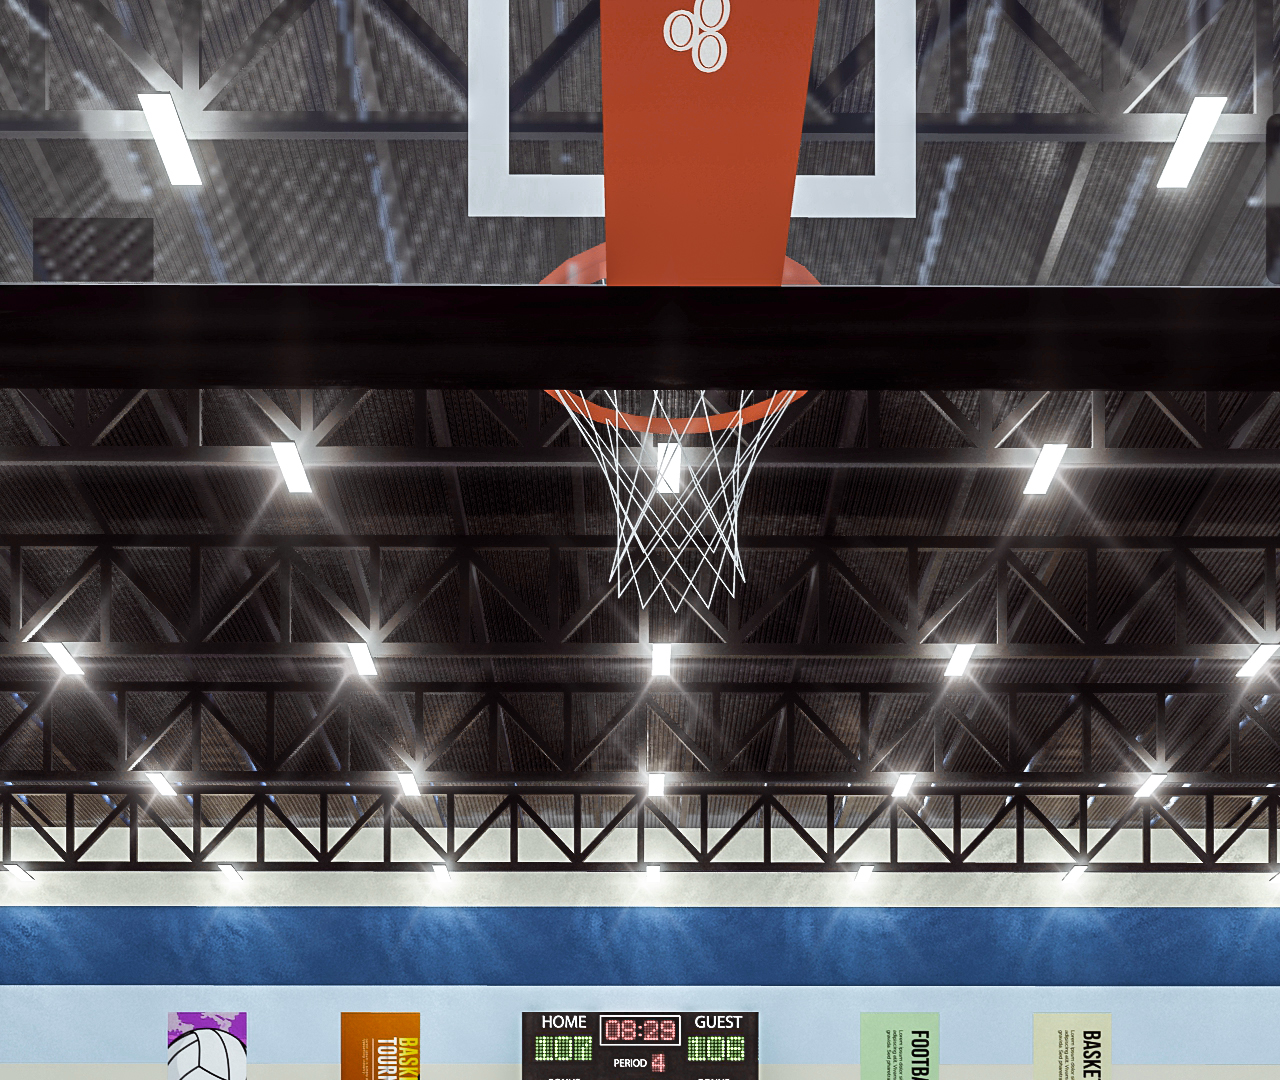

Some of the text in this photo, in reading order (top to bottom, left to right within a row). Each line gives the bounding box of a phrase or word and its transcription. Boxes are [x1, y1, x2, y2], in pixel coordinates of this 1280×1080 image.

[542, 1015, 587, 1029] HOME
[694, 1015, 744, 1029] GUEST
[535, 1036, 593, 1061] 107
[613, 1053, 666, 1073] PERIOD 4
